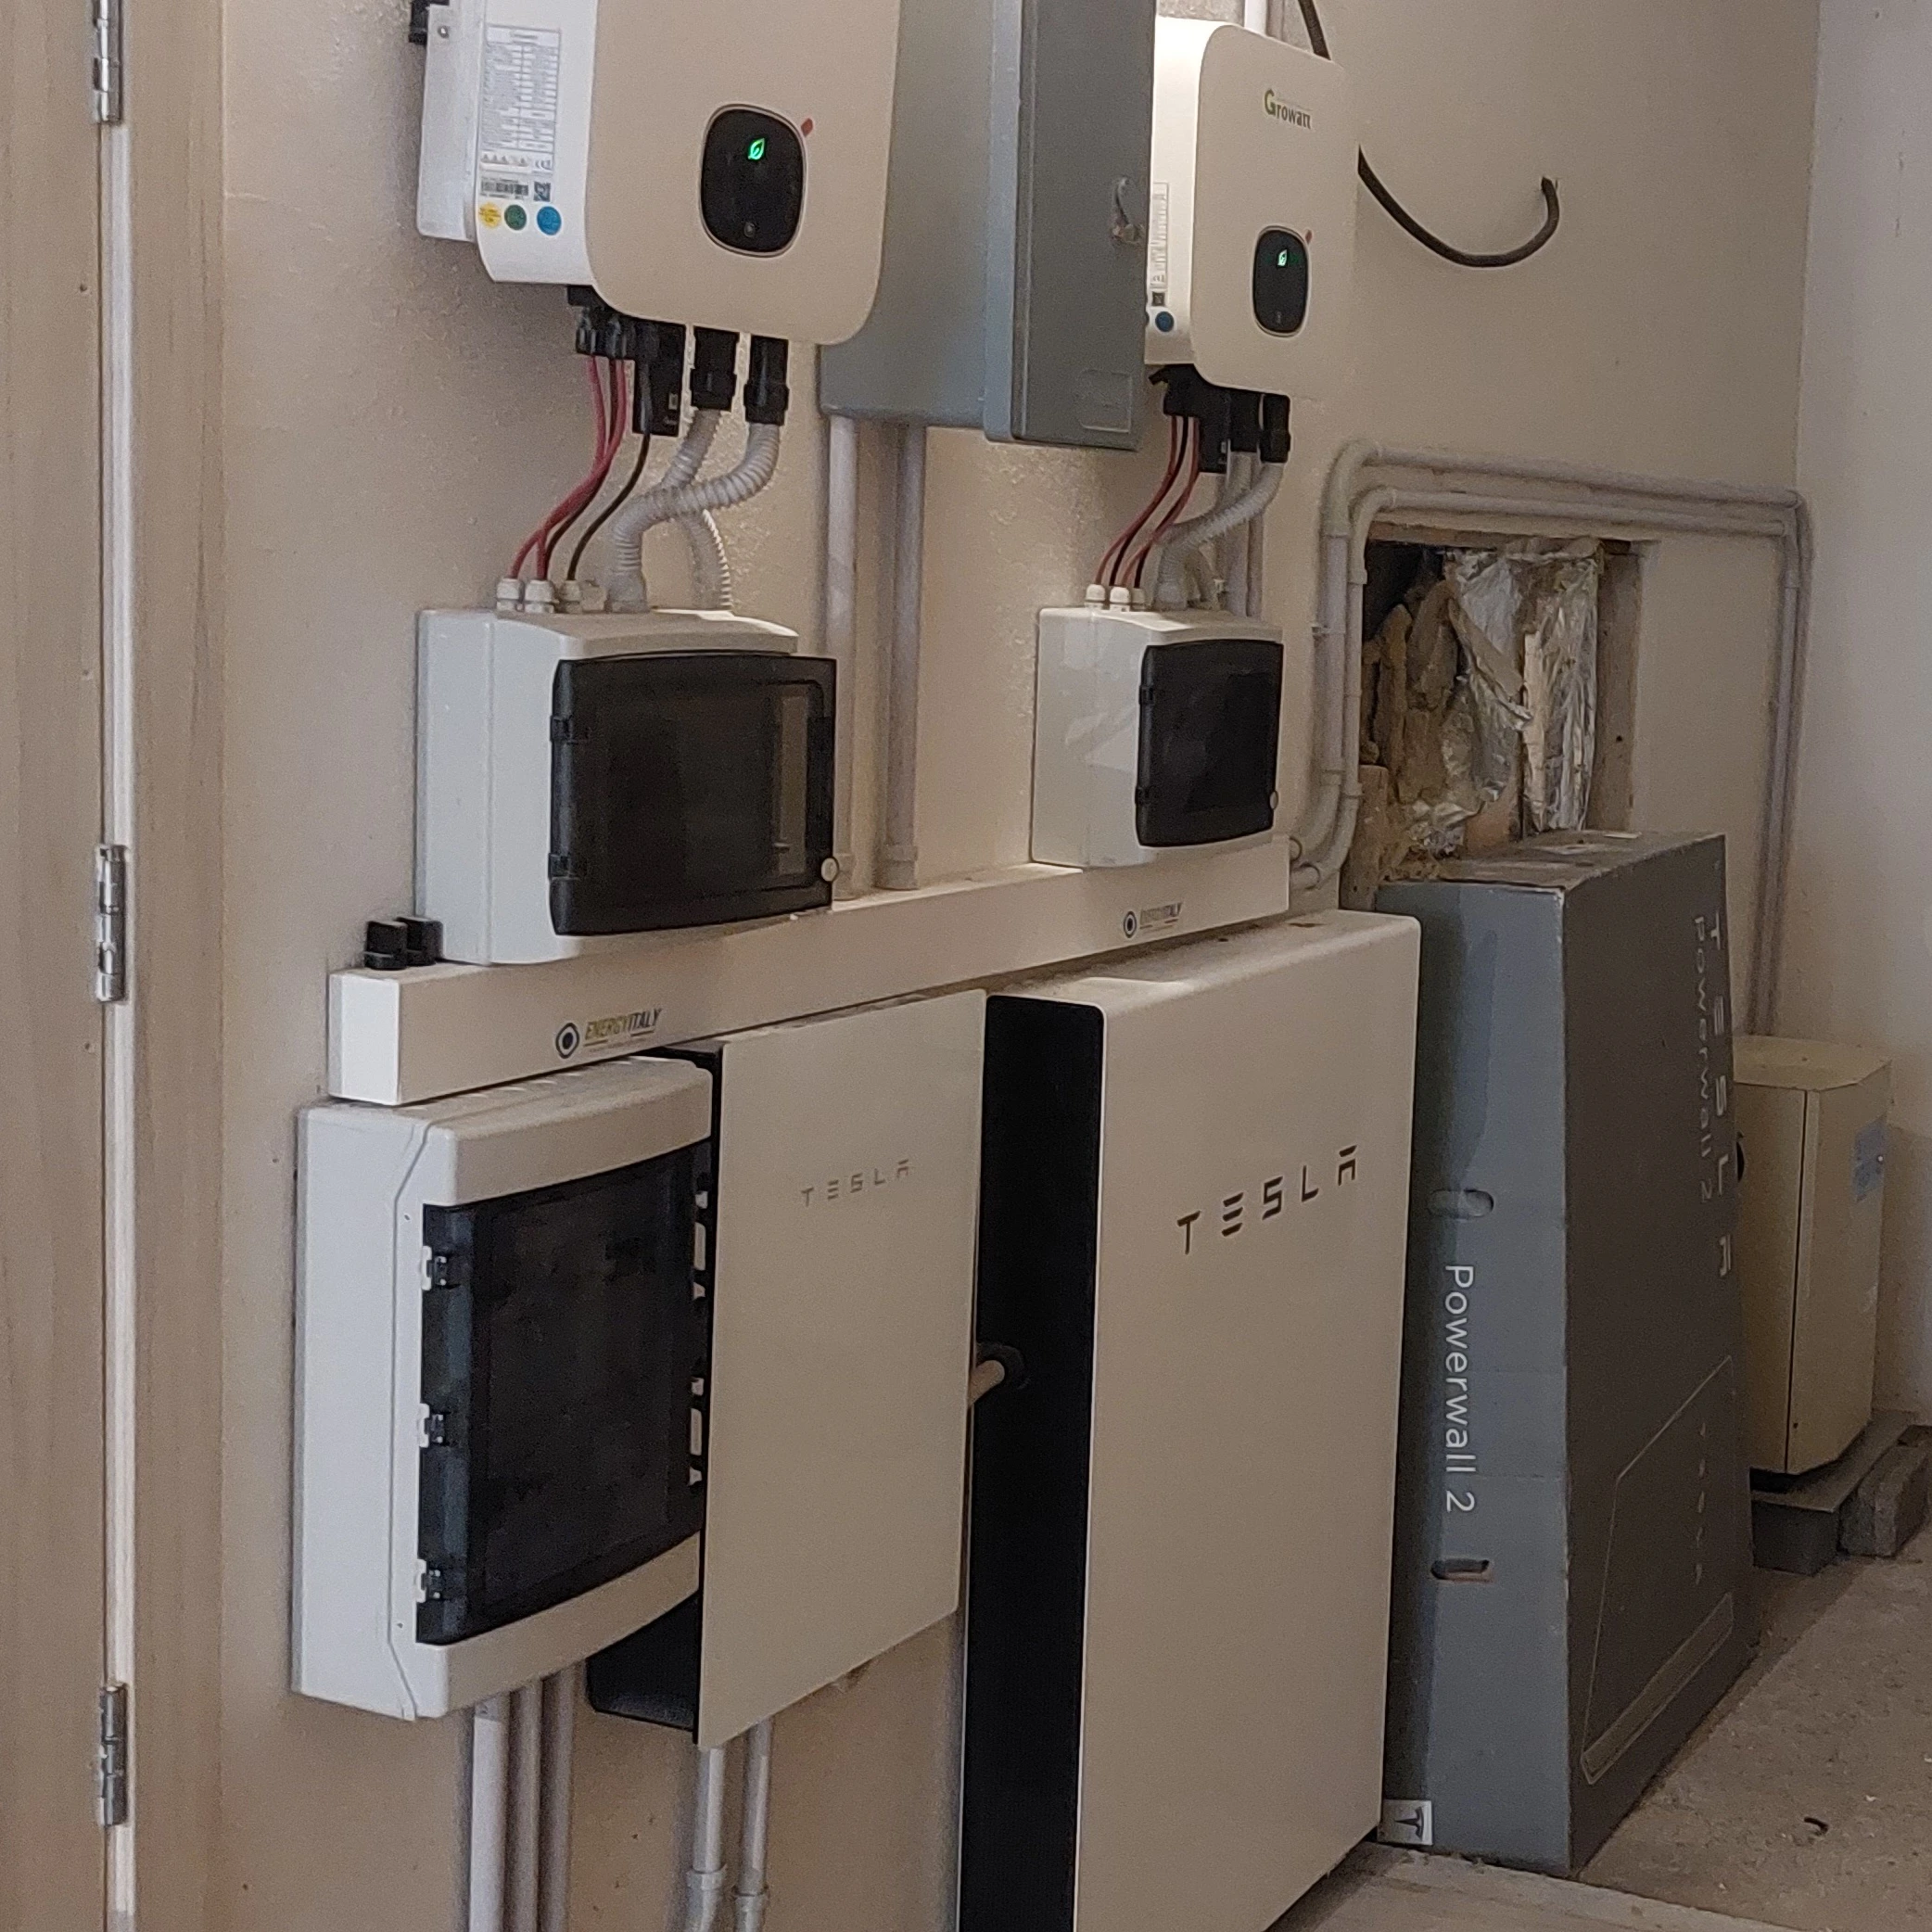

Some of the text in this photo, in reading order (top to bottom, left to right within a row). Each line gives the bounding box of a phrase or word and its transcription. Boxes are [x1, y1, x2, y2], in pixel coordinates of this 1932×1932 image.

[1264, 88, 1312, 130] Growatt
[1694, 915, 1713, 1203] Powerwall 2
[1710, 910, 1732, 1277] TESLA
[801, 1159, 909, 1206] TESLA
[1176, 1144, 1357, 1255] TESLA
[1444, 1265, 1477, 1513] Powerwall 2
